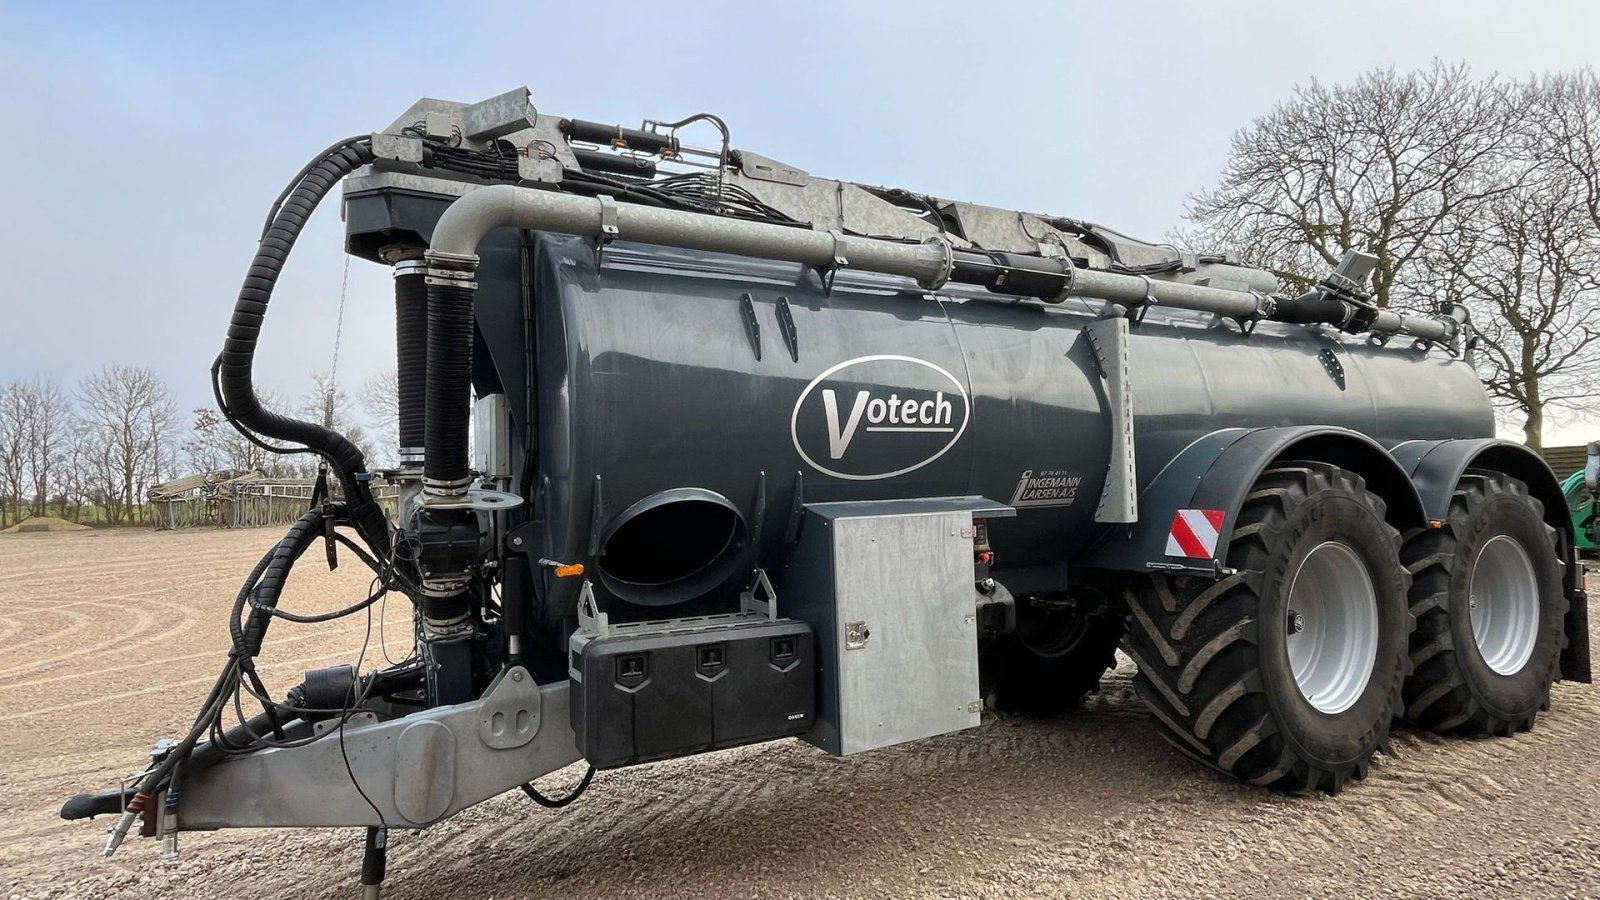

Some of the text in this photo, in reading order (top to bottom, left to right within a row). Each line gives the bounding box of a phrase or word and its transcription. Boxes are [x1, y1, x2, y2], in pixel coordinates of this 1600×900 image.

[822, 389, 952, 460] Votech
[1027, 477, 1081, 488] INGEMANN
[1022, 487, 1077, 499] LARSEN A/S
